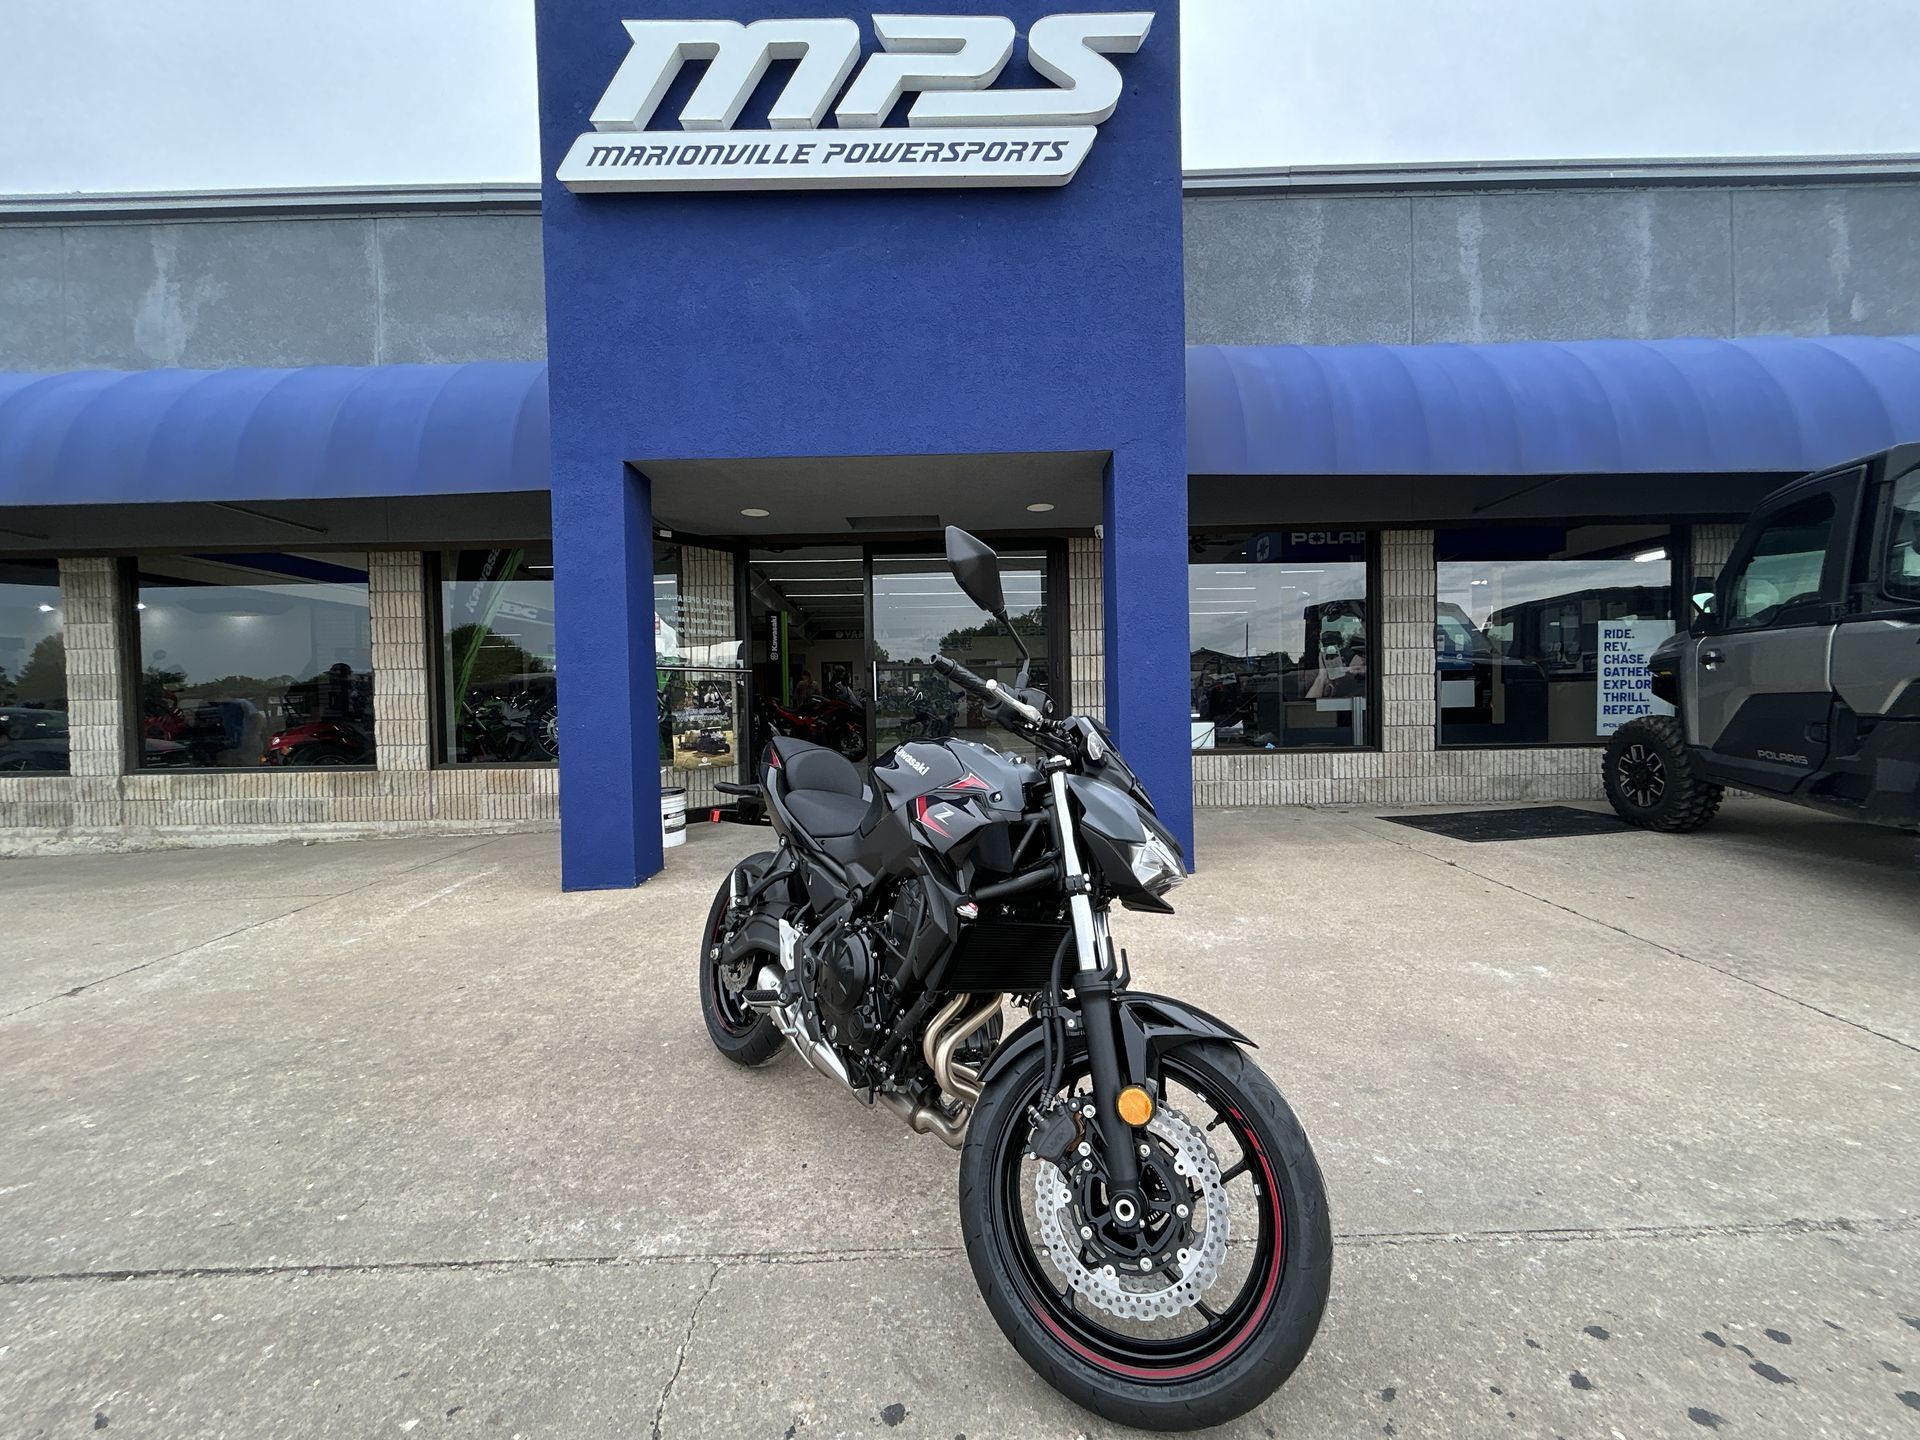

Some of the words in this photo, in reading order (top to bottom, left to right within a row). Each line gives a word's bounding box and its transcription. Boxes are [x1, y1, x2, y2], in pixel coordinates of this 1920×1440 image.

[590, 12, 1155, 131] MPS
[586, 144, 817, 167] MARIONVILLE
[822, 140, 1070, 164] POWERSPORTS
[1291, 531, 1366, 545] POLAR
[770, 615, 778, 652] Kawasaki
[1604, 629, 1635, 639] RIDE.
[1604, 642, 1631, 651] REV.
[1603, 654, 1648, 664] CHASE.
[1603, 680, 1651, 689] EXPLOR
[1603, 692, 1650, 702] THRILL.
[1603, 705, 1653, 715] REPEAT.
[893, 744, 931, 776] Kawasaki
[1756, 749, 1809, 765] POLARIS
